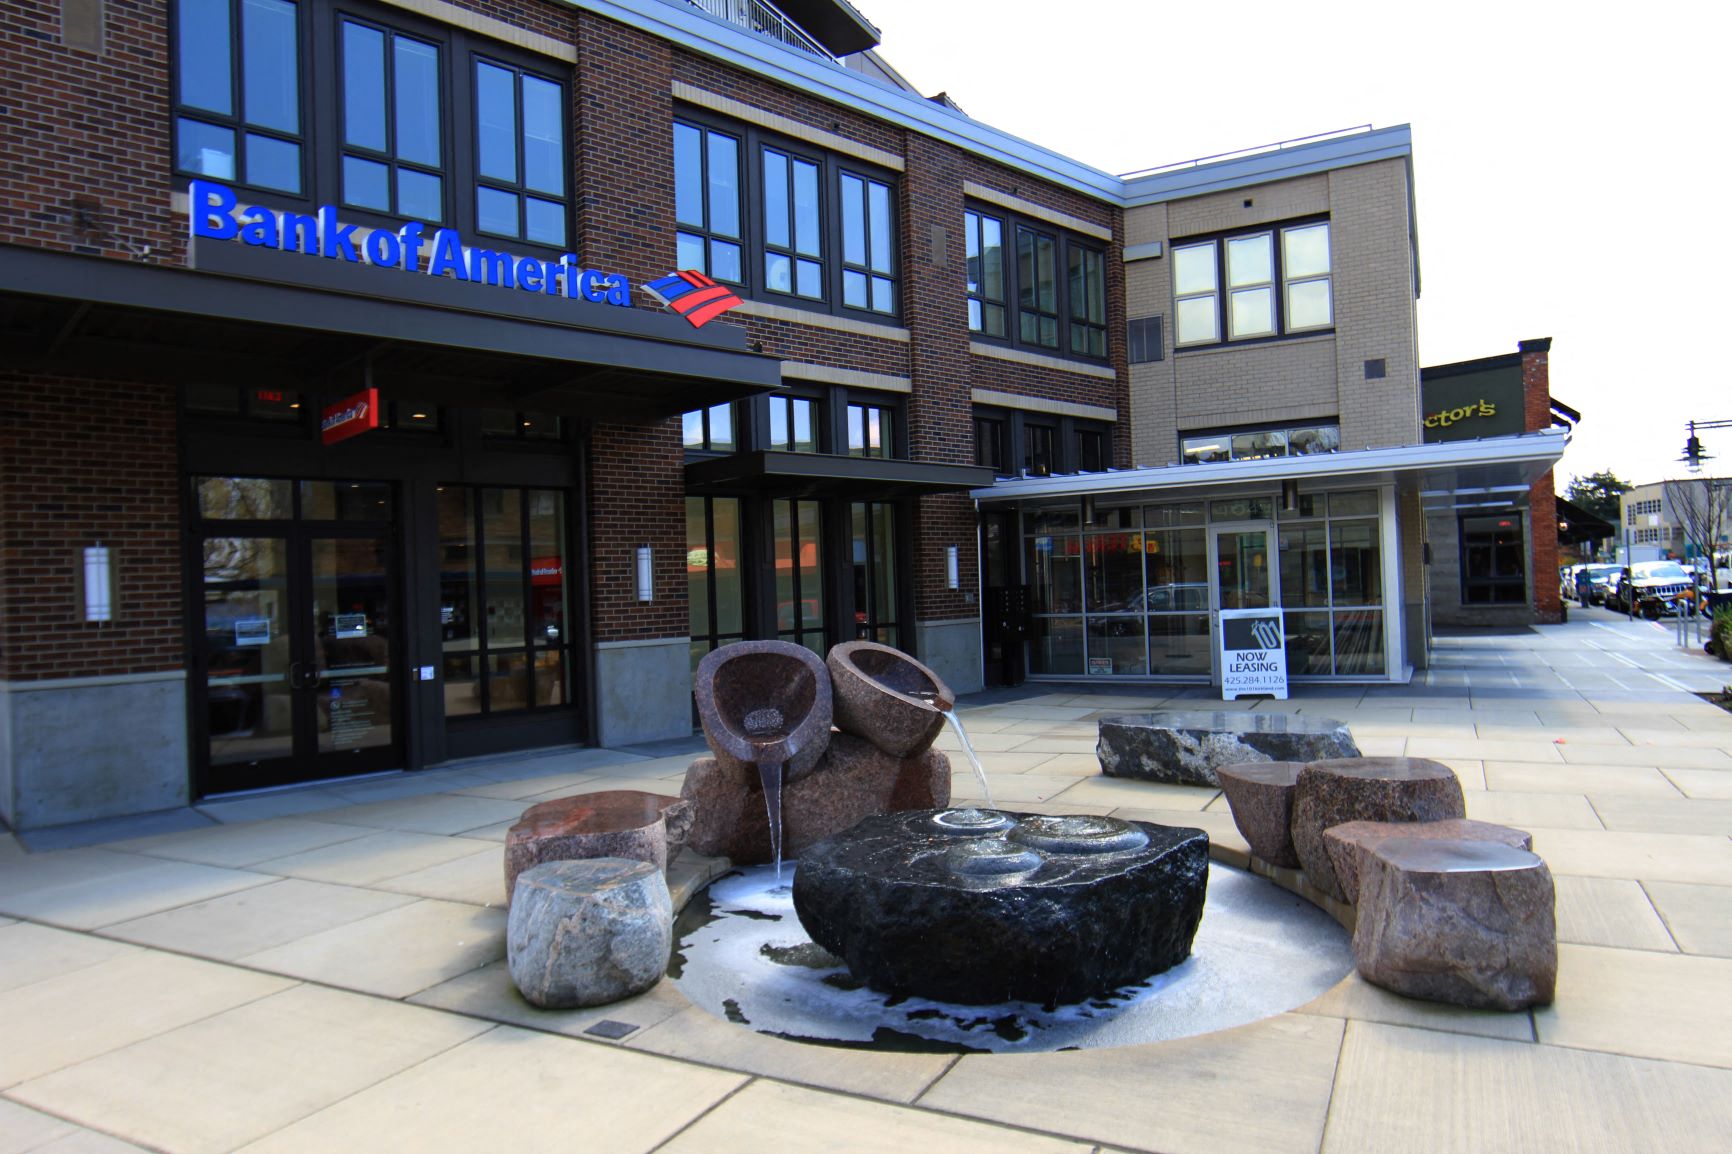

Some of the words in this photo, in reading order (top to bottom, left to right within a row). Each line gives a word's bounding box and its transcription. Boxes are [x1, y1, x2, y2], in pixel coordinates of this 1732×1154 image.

[188, 178, 359, 263] Bank
[361, 221, 425, 273] of
[427, 228, 633, 308] America
[1422, 399, 1496, 428] ctor's
[1236, 651, 1268, 662] NOW
[1229, 662, 1278, 673] LEASING
[1224, 675, 1285, 685] 425.284.1126
